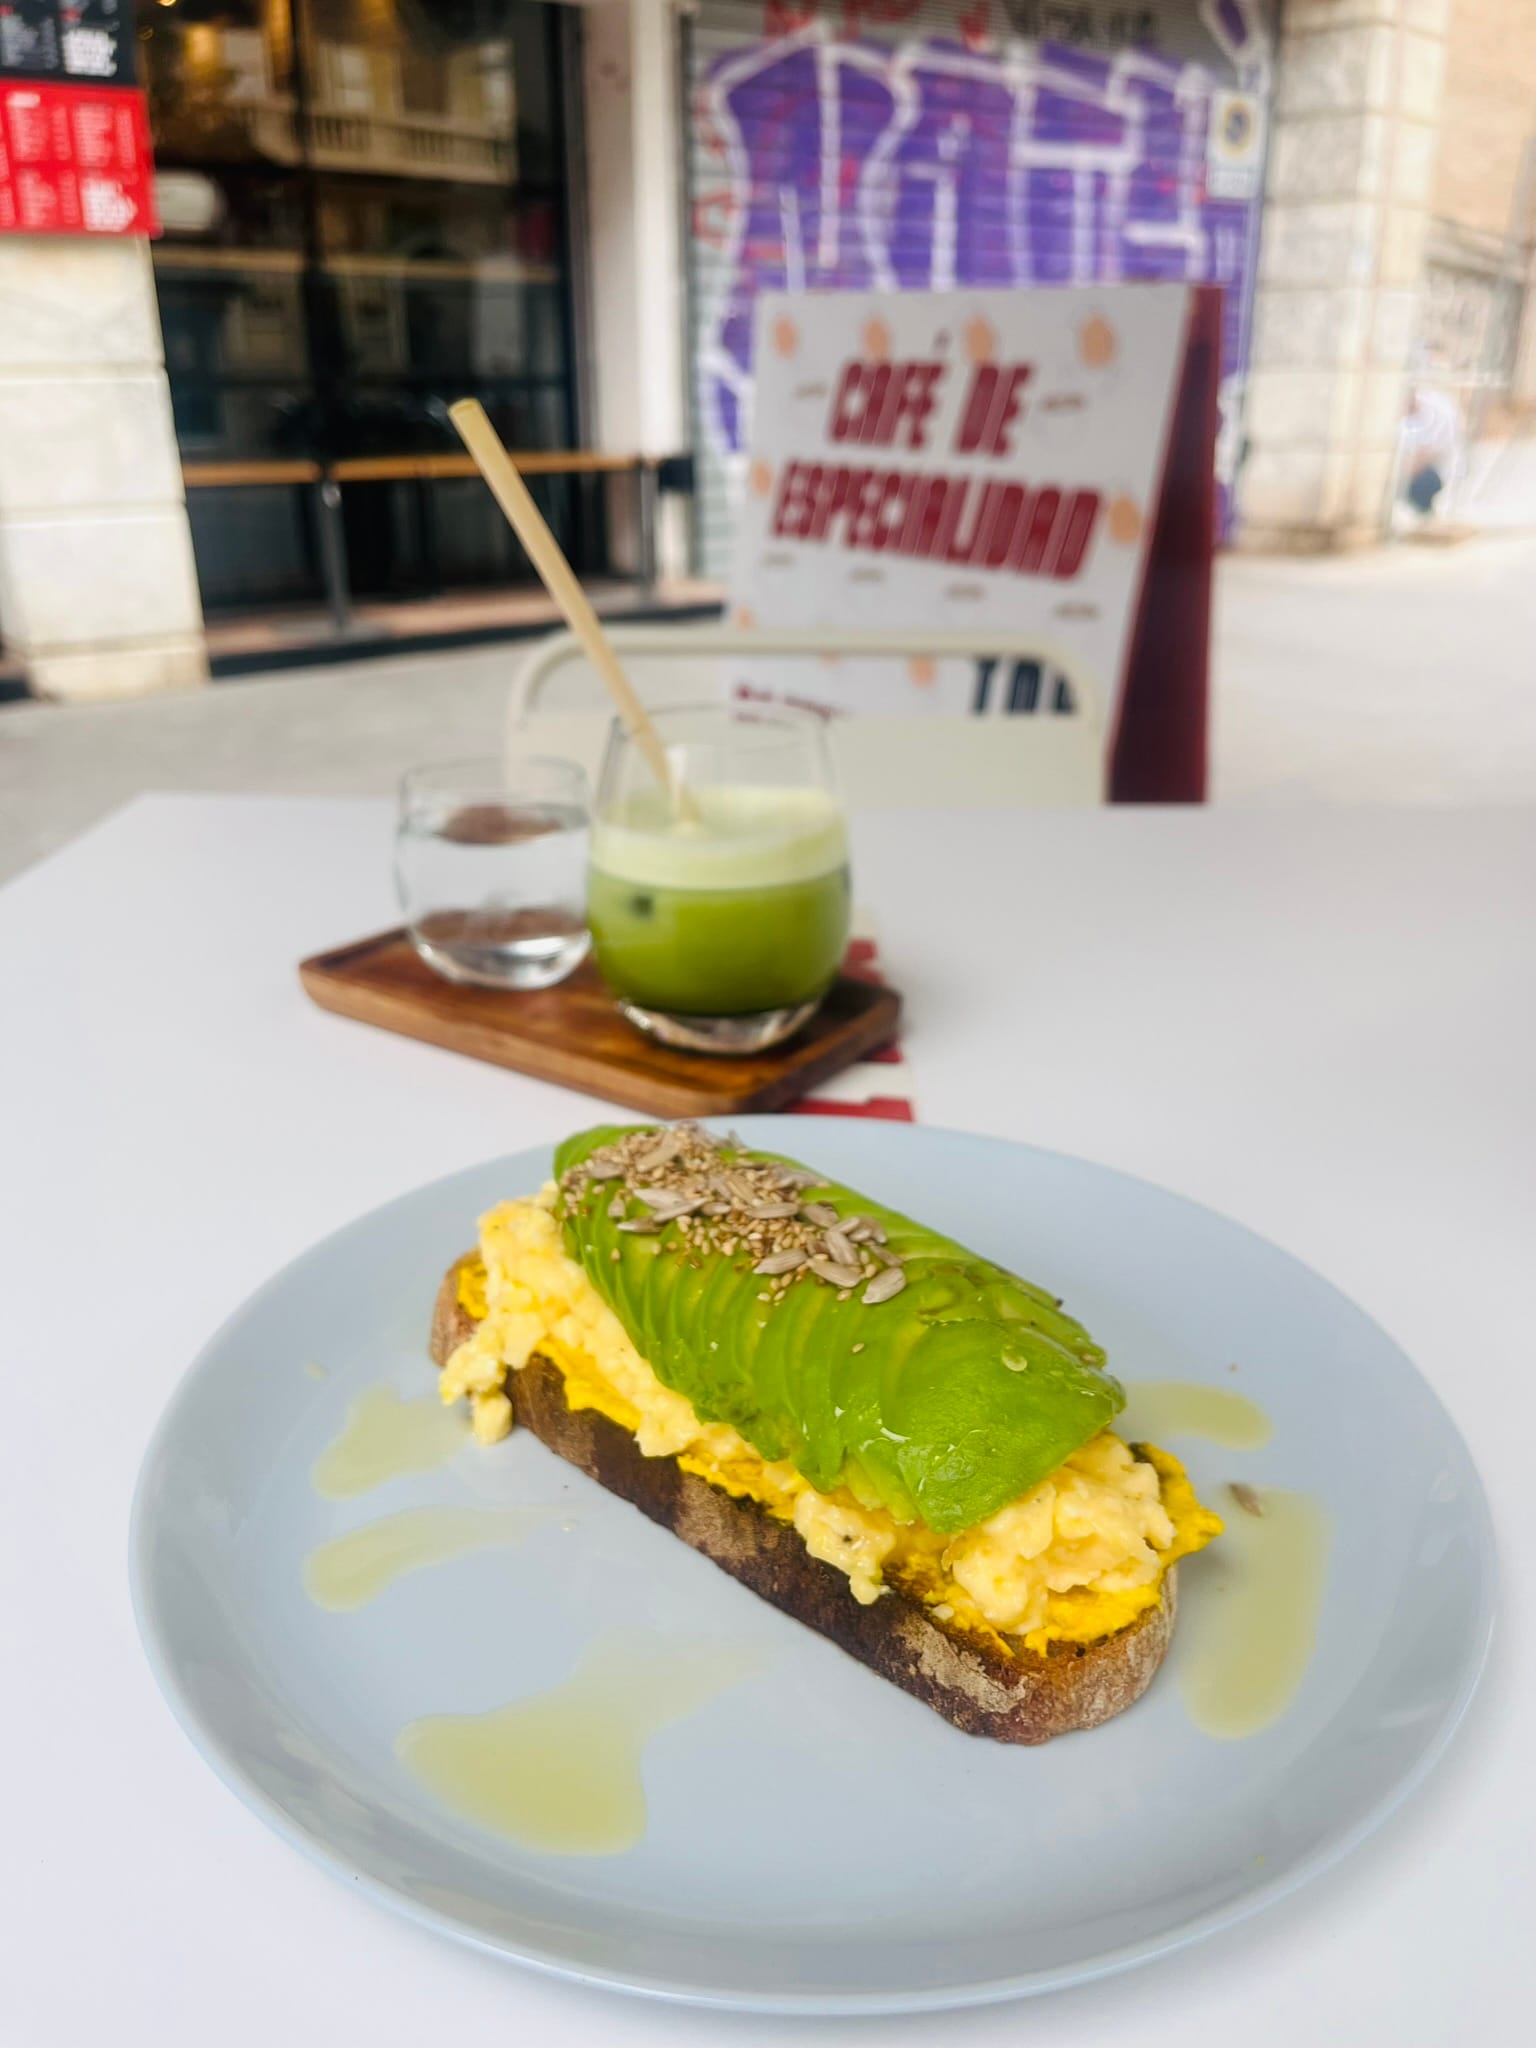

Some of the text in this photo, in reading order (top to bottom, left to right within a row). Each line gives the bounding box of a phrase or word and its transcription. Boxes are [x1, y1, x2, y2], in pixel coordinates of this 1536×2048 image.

[828, 328, 1032, 456] CAFÉ DE
[772, 460, 1104, 580] ESPECIALIDAD
